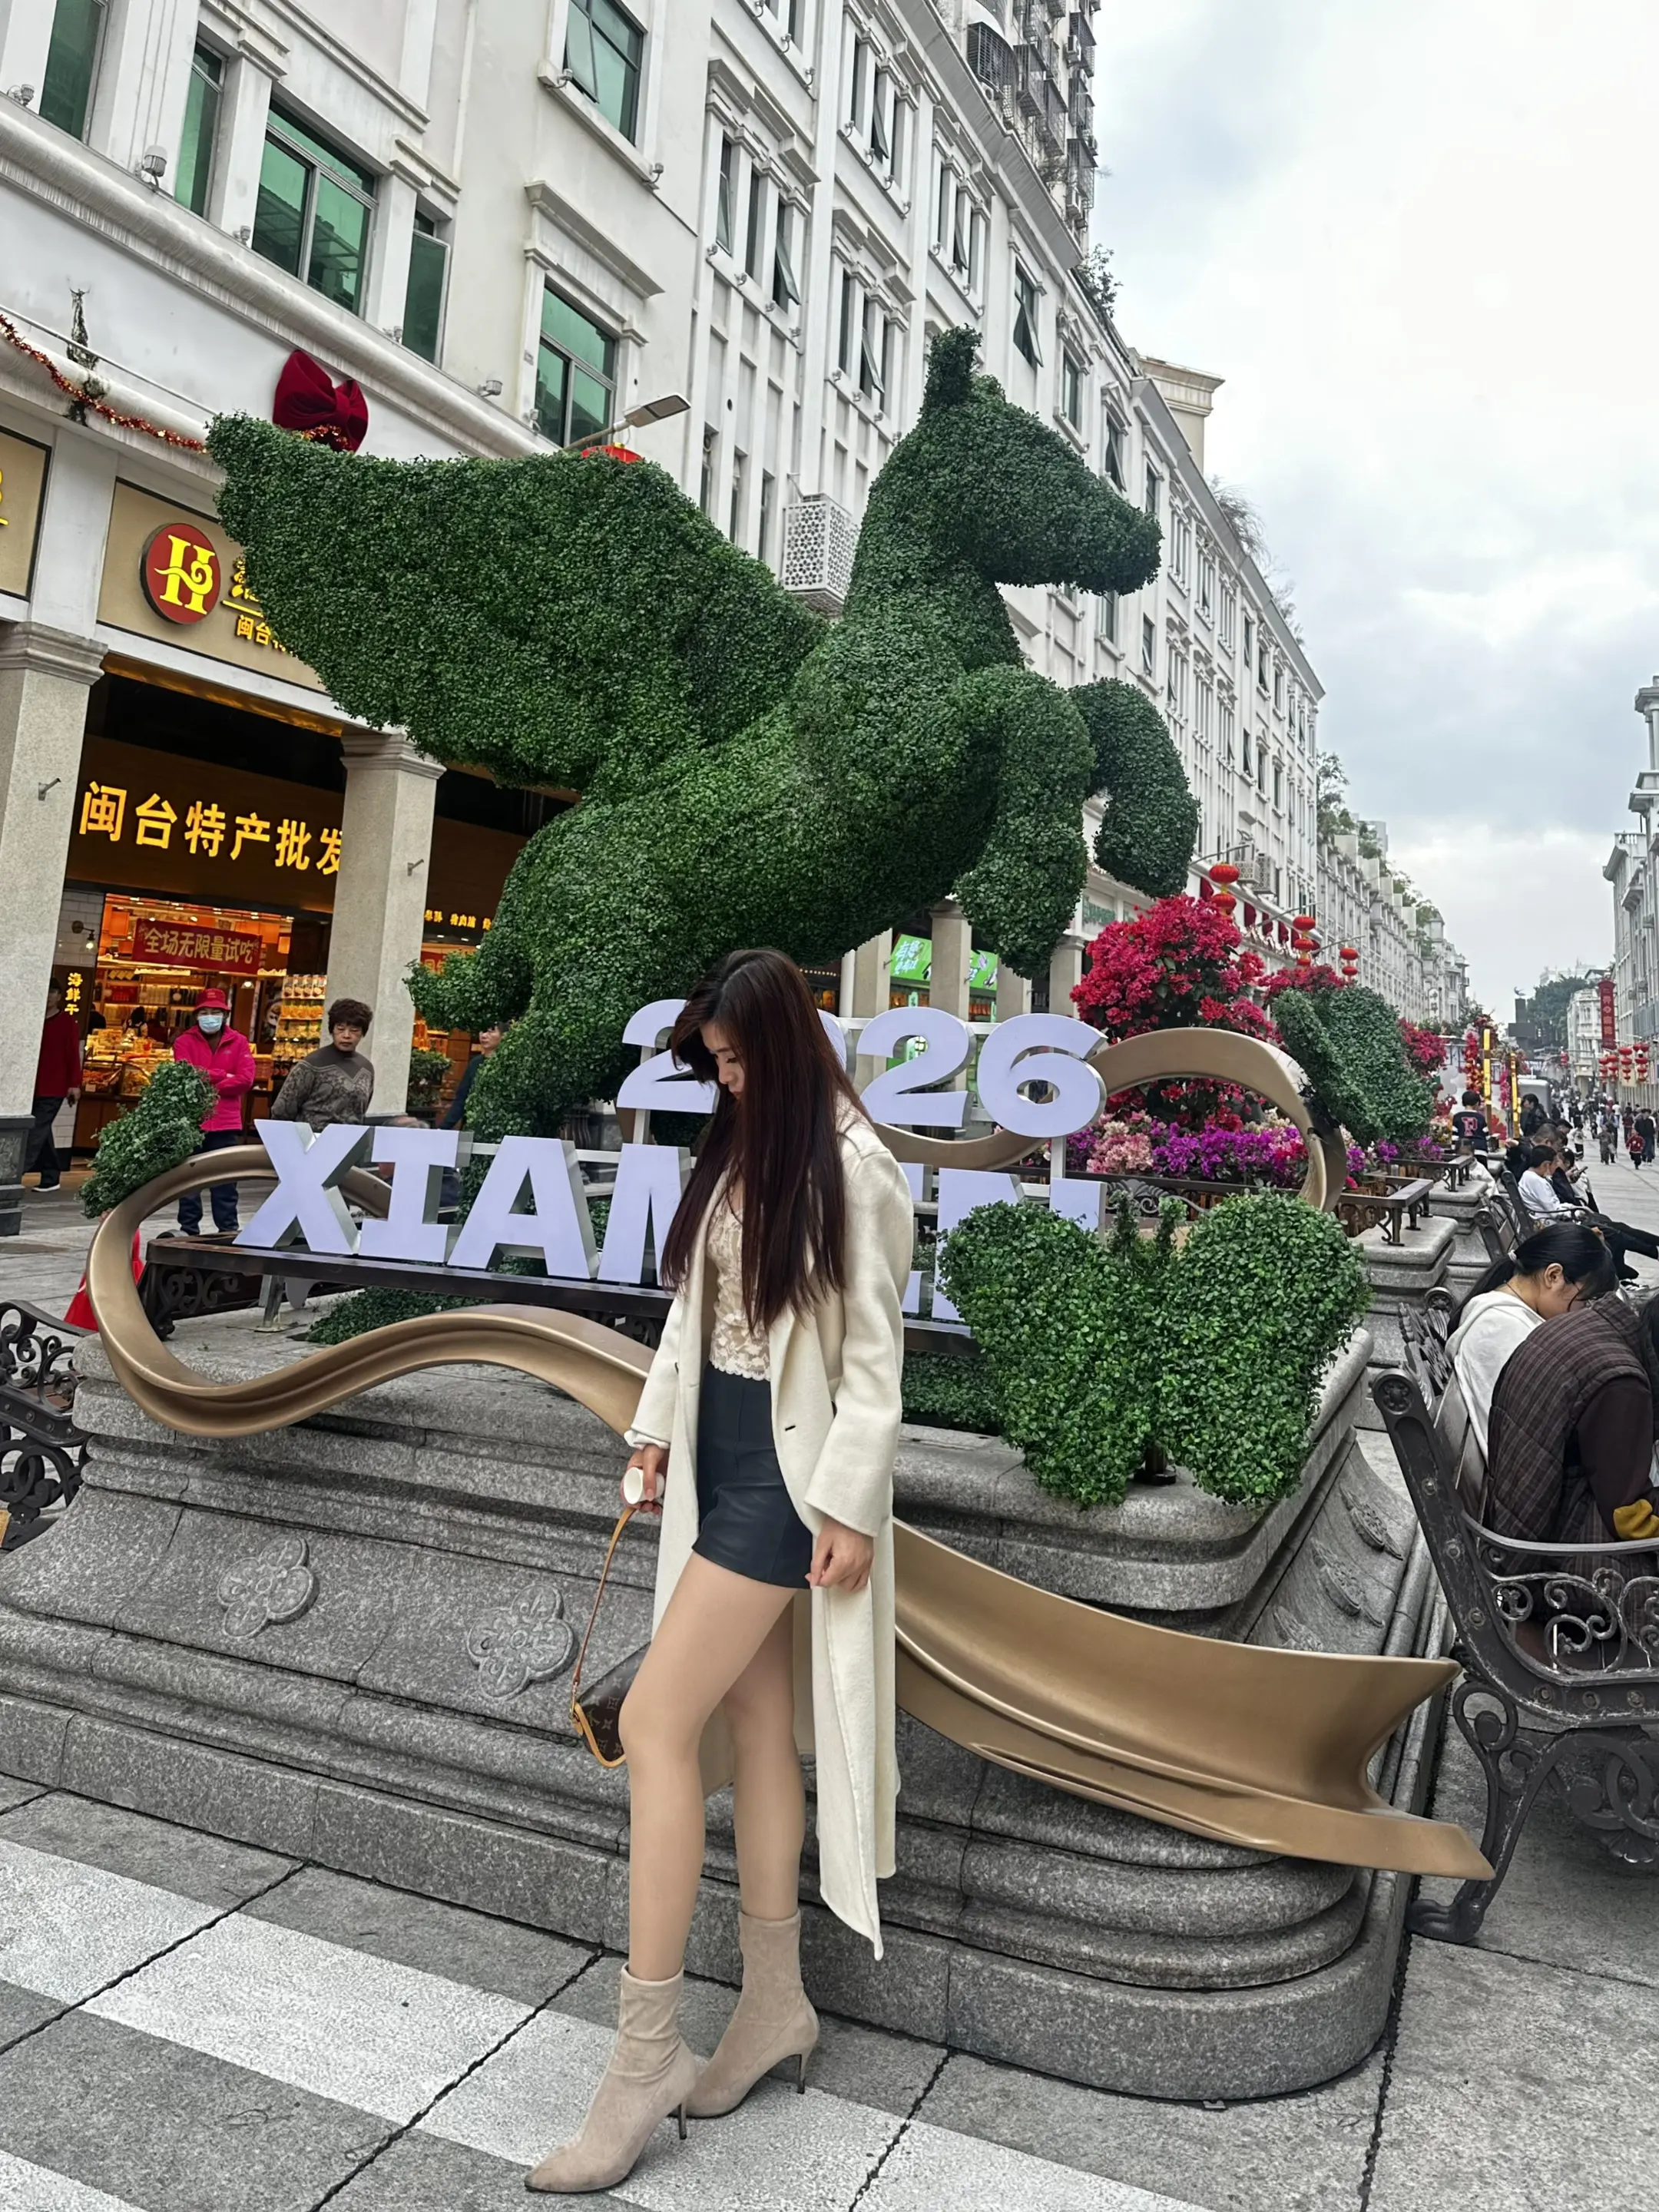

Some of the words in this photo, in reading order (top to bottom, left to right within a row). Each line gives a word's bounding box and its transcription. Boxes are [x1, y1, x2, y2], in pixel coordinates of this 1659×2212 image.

[79, 781, 343, 876] 闽台特产批发
[144, 927, 254, 965] 全场无限量试吃
[616, 998, 1101, 1137] 226
